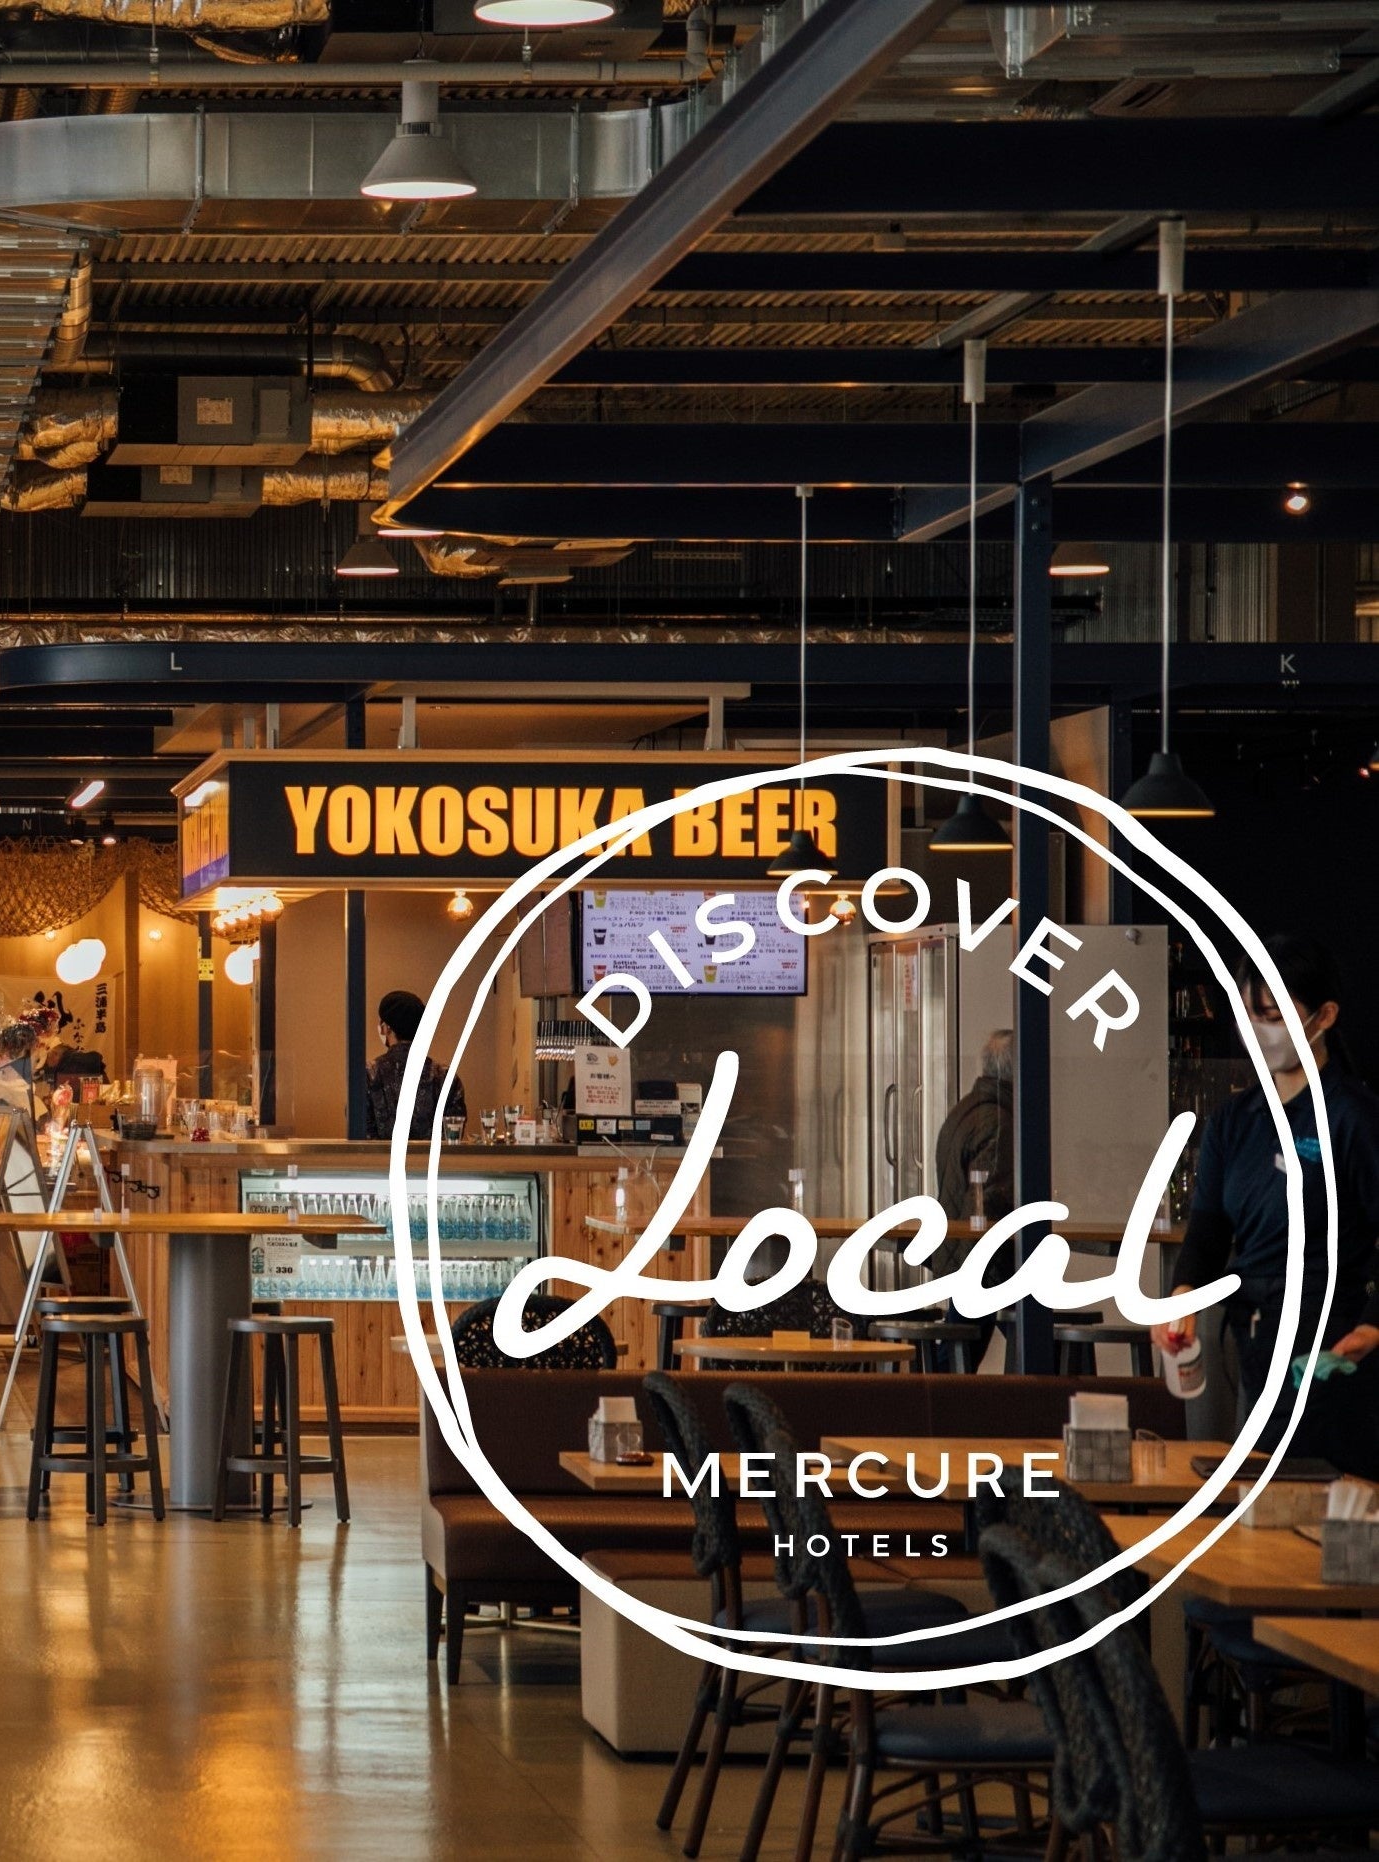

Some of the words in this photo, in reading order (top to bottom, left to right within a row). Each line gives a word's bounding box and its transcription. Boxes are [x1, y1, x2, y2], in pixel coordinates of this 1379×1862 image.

[171, 652, 182, 670] L
[1281, 654, 1296, 673] K
[285, 786, 652, 857] YOKOSUKA
[673, 788, 837, 857] BEER
[94, 982, 108, 1034] 三浦半島
